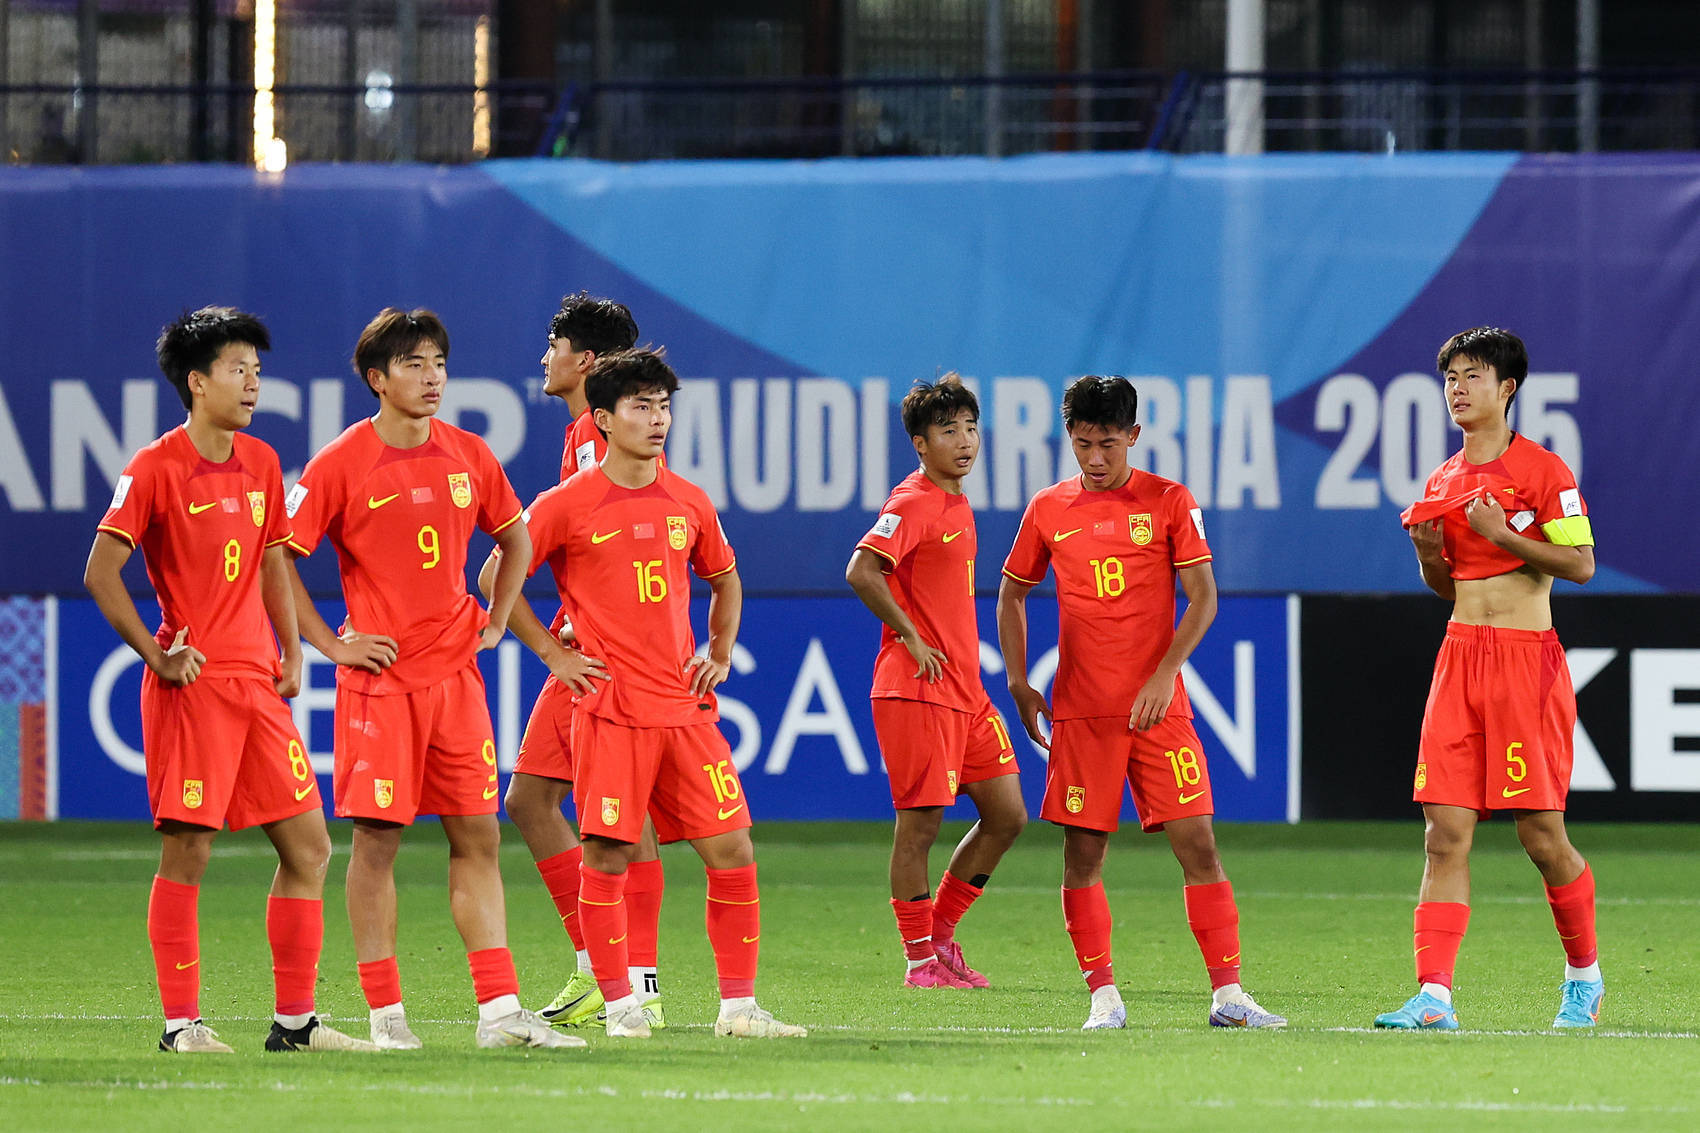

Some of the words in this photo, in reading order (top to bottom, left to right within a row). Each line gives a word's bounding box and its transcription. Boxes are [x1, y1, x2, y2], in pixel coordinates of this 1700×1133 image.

[670, 376, 889, 513] AUDI
[964, 373, 1282, 511] RBIA
[1314, 372, 1583, 510] 205
[224, 539, 241, 582] 8
[417, 525, 441, 570] 9
[633, 560, 667, 603] 16
[1089, 557, 1126, 598] 18
[287, 739, 309, 782] 8
[481, 739, 498, 783] 9
[703, 759, 740, 804] 16
[1164, 746, 1201, 789] 18
[1506, 741, 1527, 782] 5
